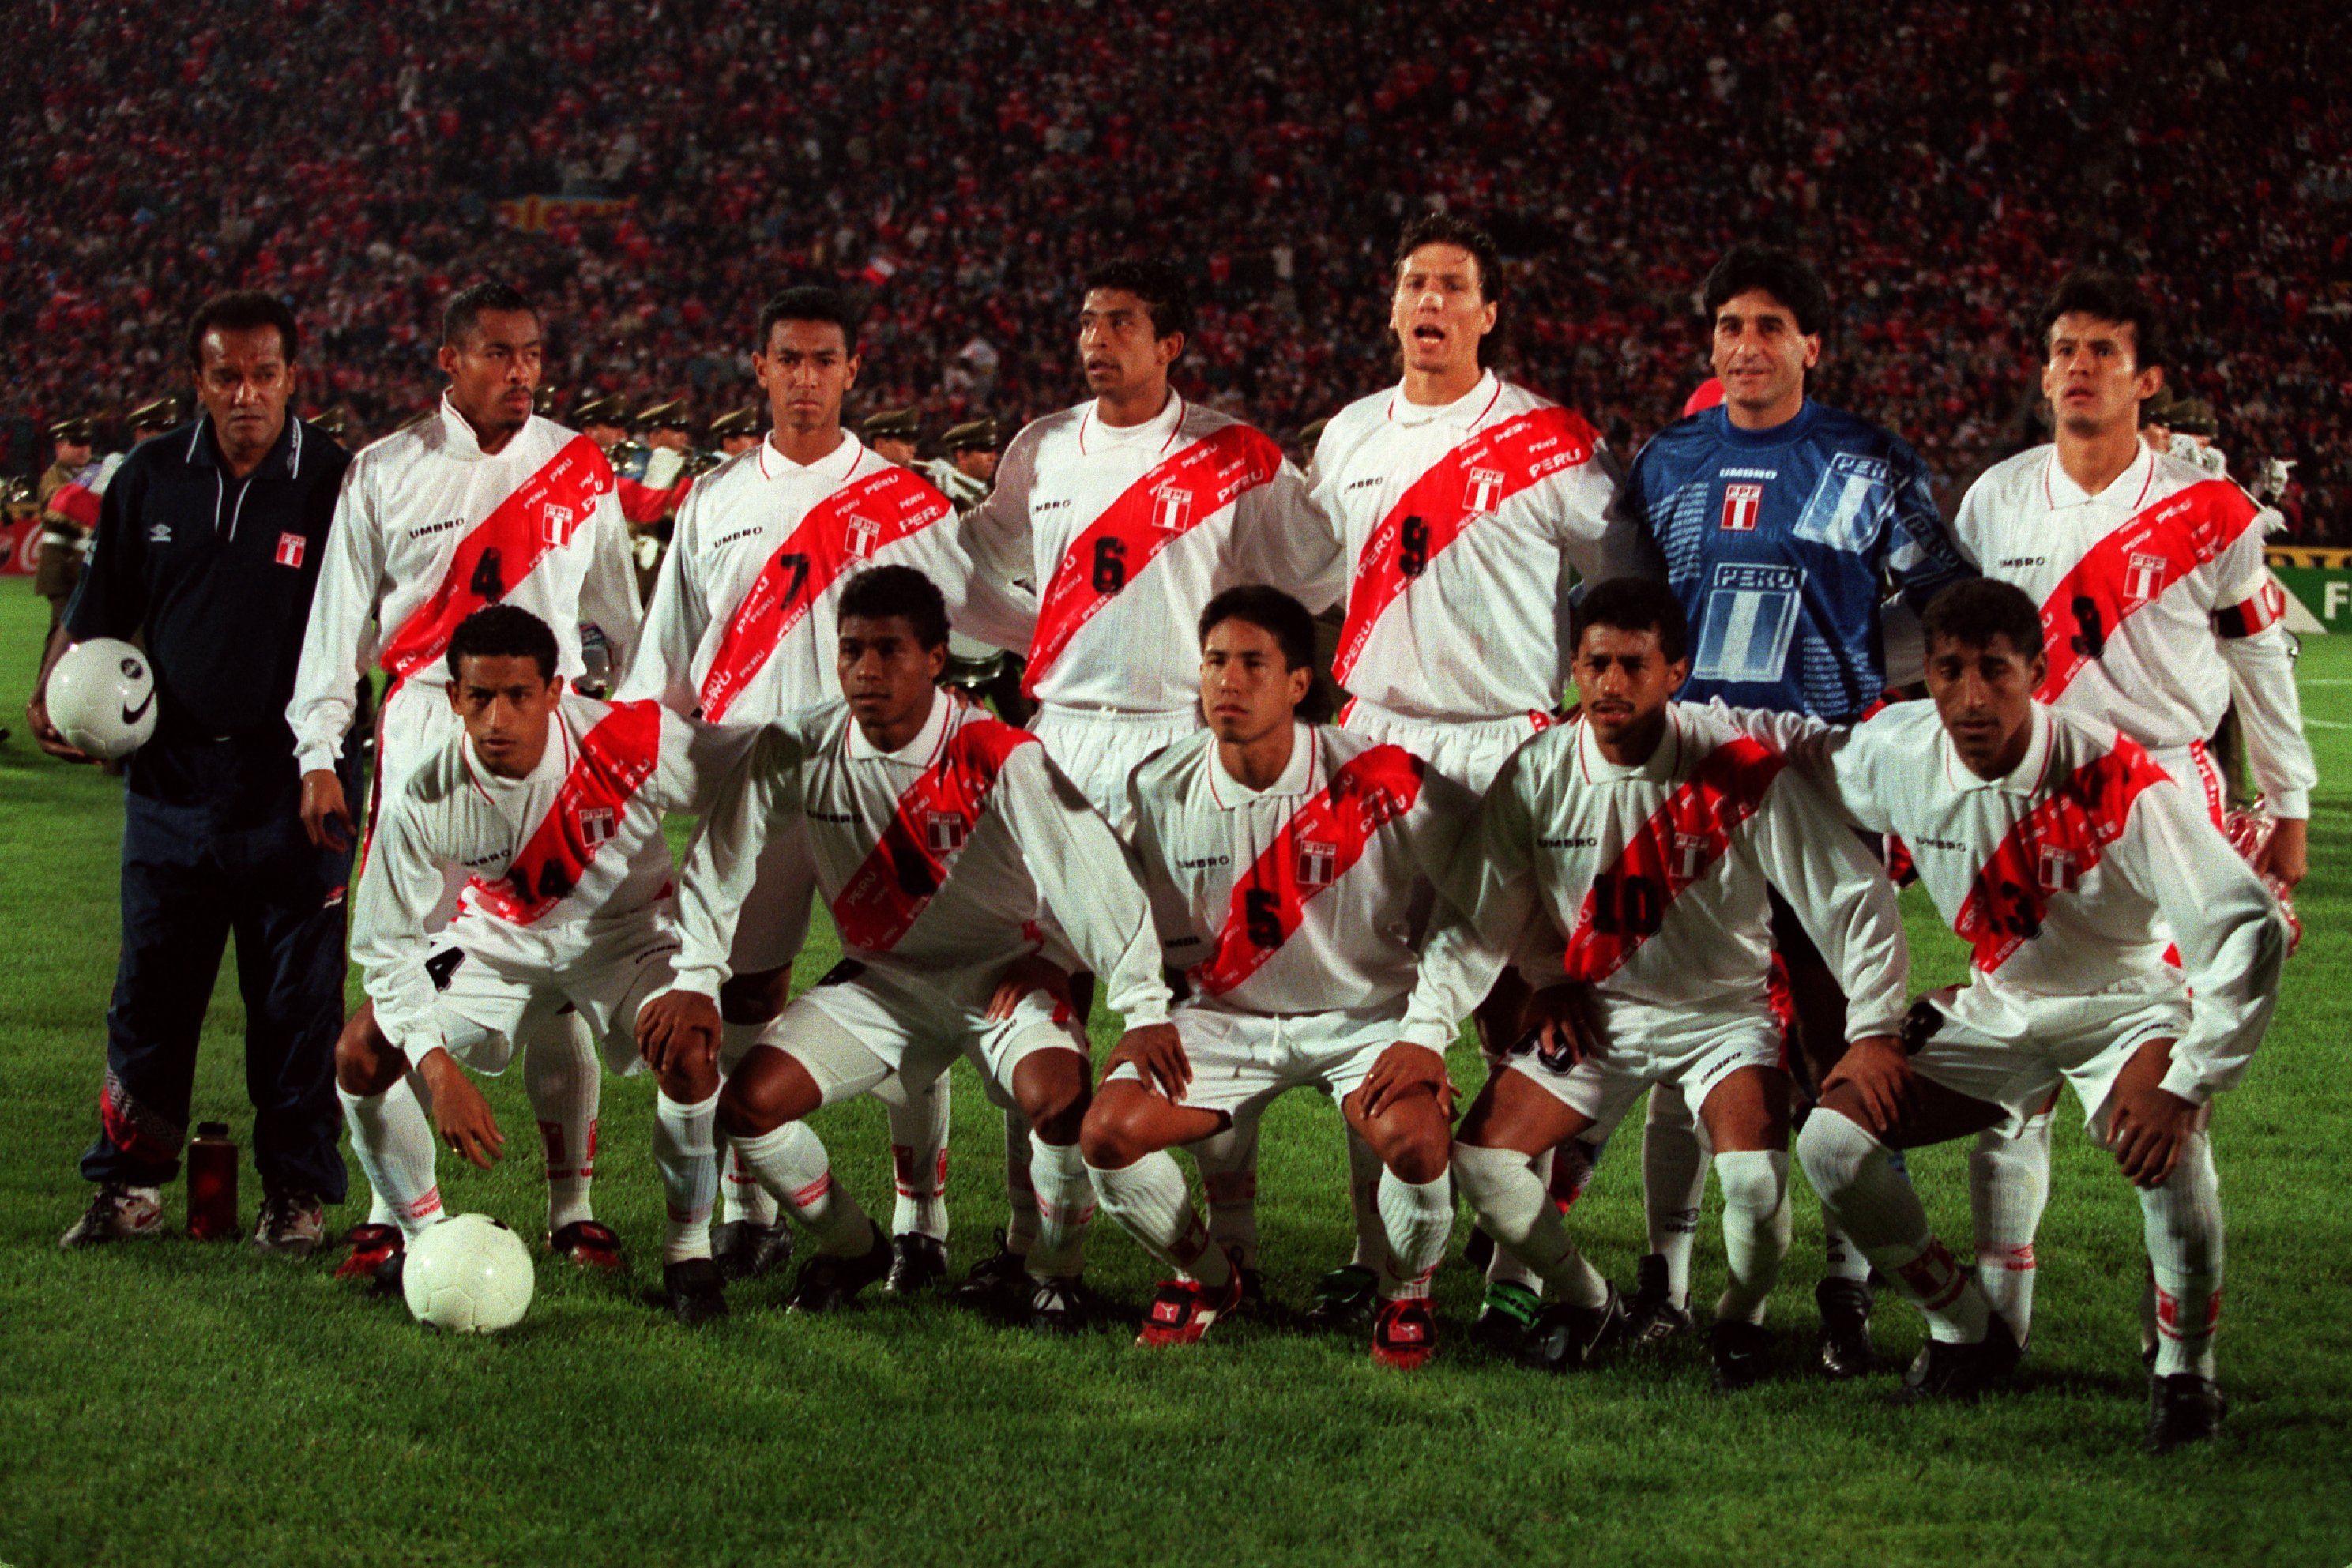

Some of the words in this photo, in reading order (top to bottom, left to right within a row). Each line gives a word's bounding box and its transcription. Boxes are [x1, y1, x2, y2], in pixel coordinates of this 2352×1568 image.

[1181, 443, 1218, 468] PERU
[1528, 436, 1558, 453] PERU
[1460, 448, 1488, 469] PERU
[1528, 448, 1581, 479] PERU
[1837, 455, 1891, 479] PER
[865, 474, 899, 495] PERU
[1344, 476, 1384, 494] MBRO
[1719, 468, 1778, 480] UMBRO
[900, 492, 925, 509] PERU
[1728, 486, 1760, 498] FPF
[835, 499, 860, 517] PERU
[1034, 498, 1071, 513] MBRO
[409, 517, 465, 539] UMBRO
[713, 526, 762, 548] UMBRO
[1357, 525, 1395, 579] PERU
[471, 547, 503, 603] 4
[1092, 536, 1127, 594] 6
[780, 552, 810, 611] 7
[1722, 568, 1797, 589] PERU
[2324, 581, 2350, 620] F
[777, 603, 809, 640] PERU
[1343, 619, 1372, 670] PERU
[739, 649, 765, 678] PERU
[1537, 837, 1597, 848] UMBRO
[463, 848, 512, 867] MBRO
[1594, 873, 1661, 935] 10
[1245, 889, 1283, 948] 5
